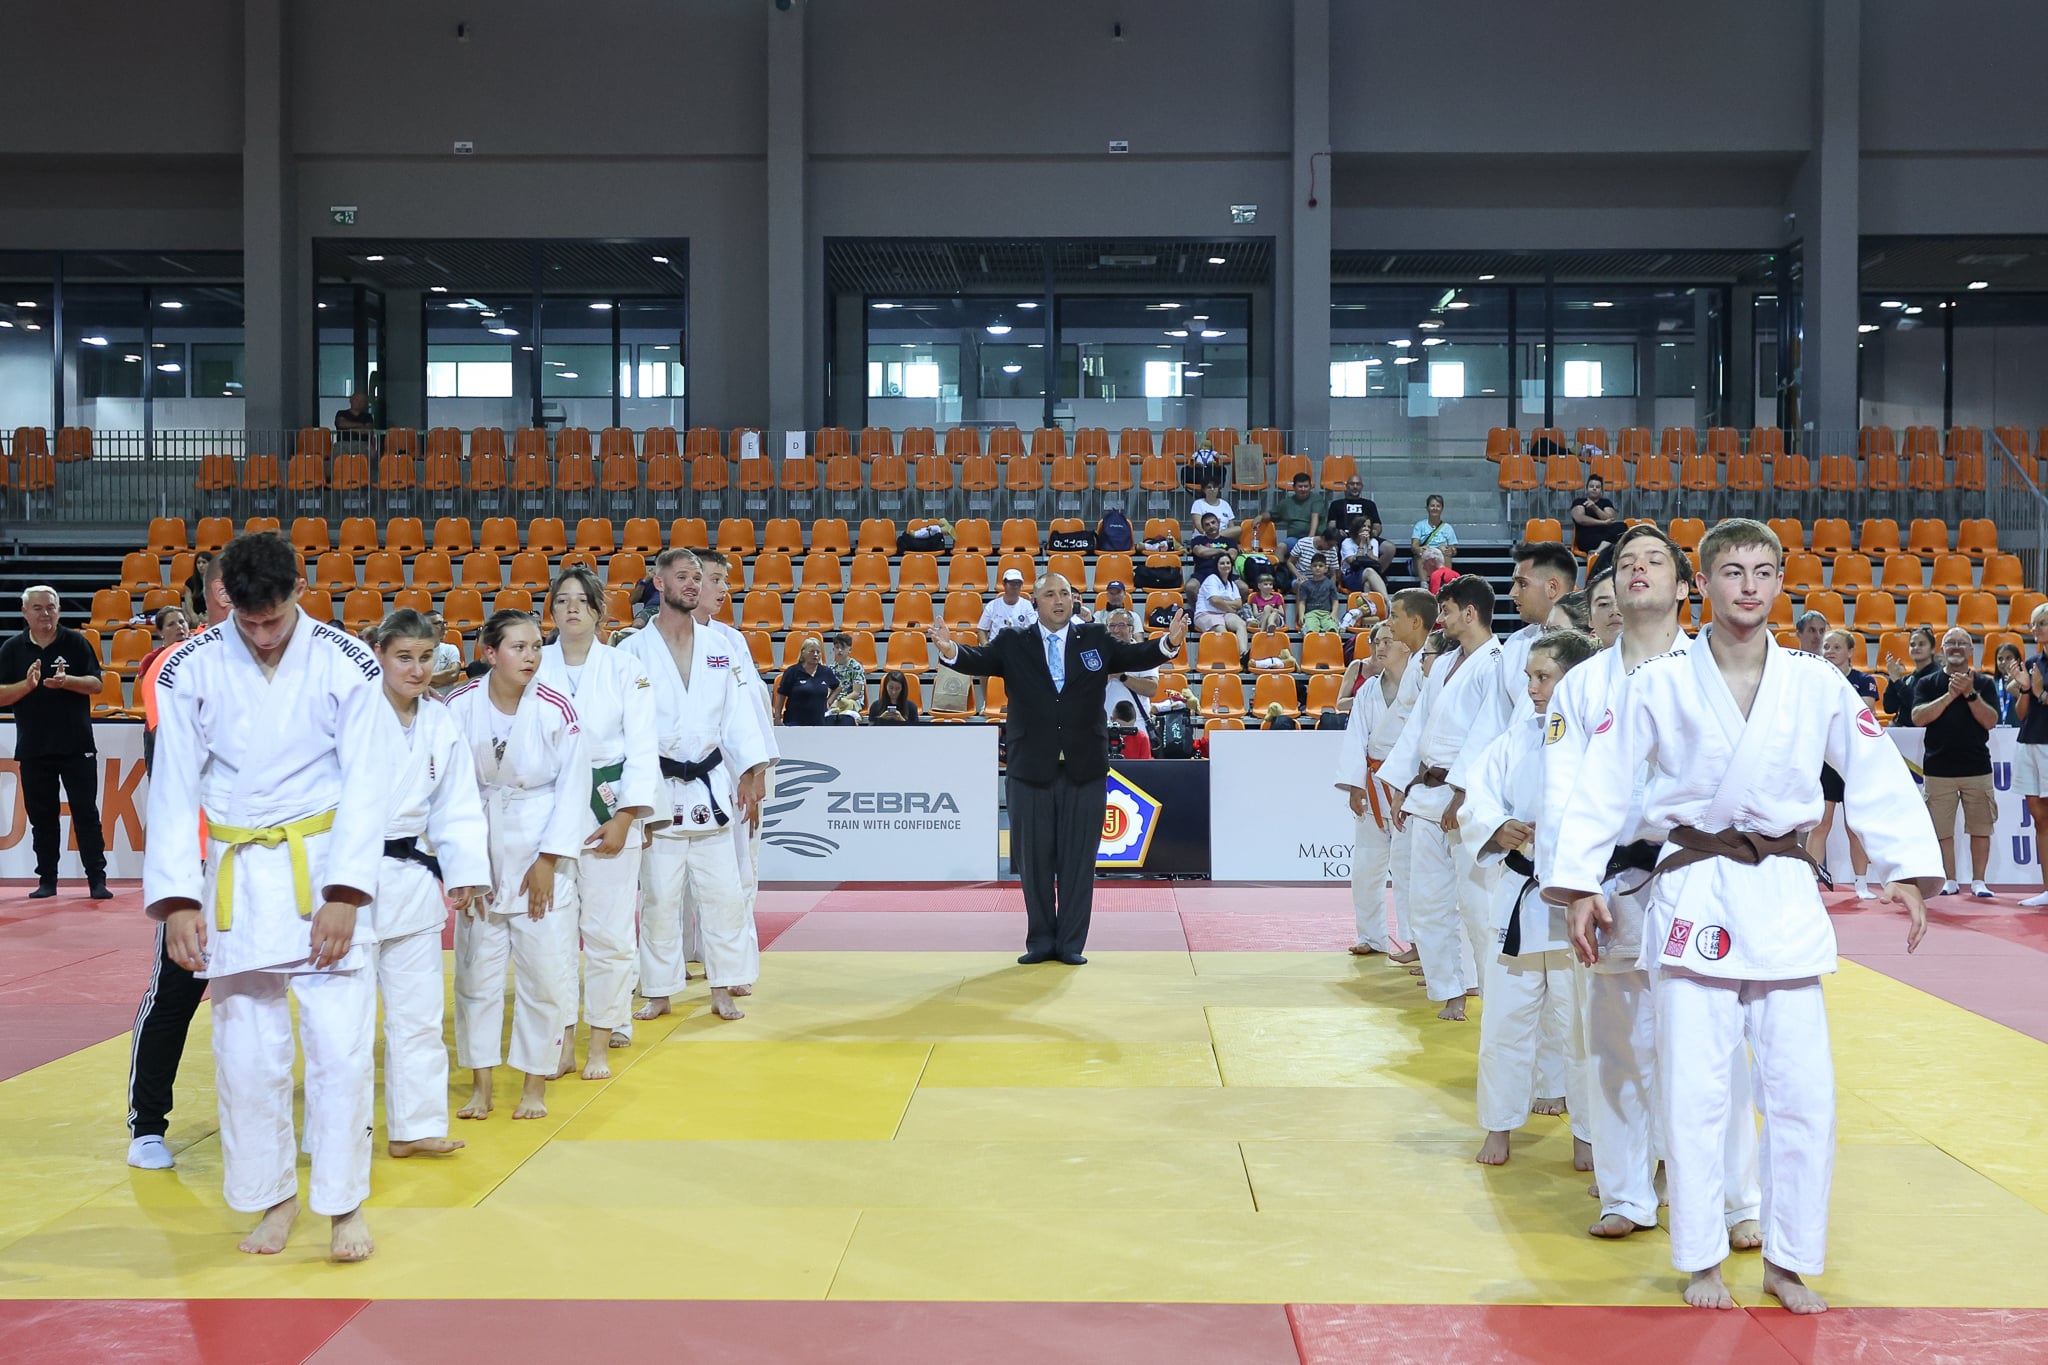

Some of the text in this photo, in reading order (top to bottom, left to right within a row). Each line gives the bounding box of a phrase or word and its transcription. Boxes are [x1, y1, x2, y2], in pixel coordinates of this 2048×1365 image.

[157, 627, 224, 689] IPPONGEAR
[312, 624, 381, 682] IPPONGEAR
[827, 791, 960, 814] ZEBRA
[827, 819, 961, 830] TRAIN WITH CONFIDENCE
